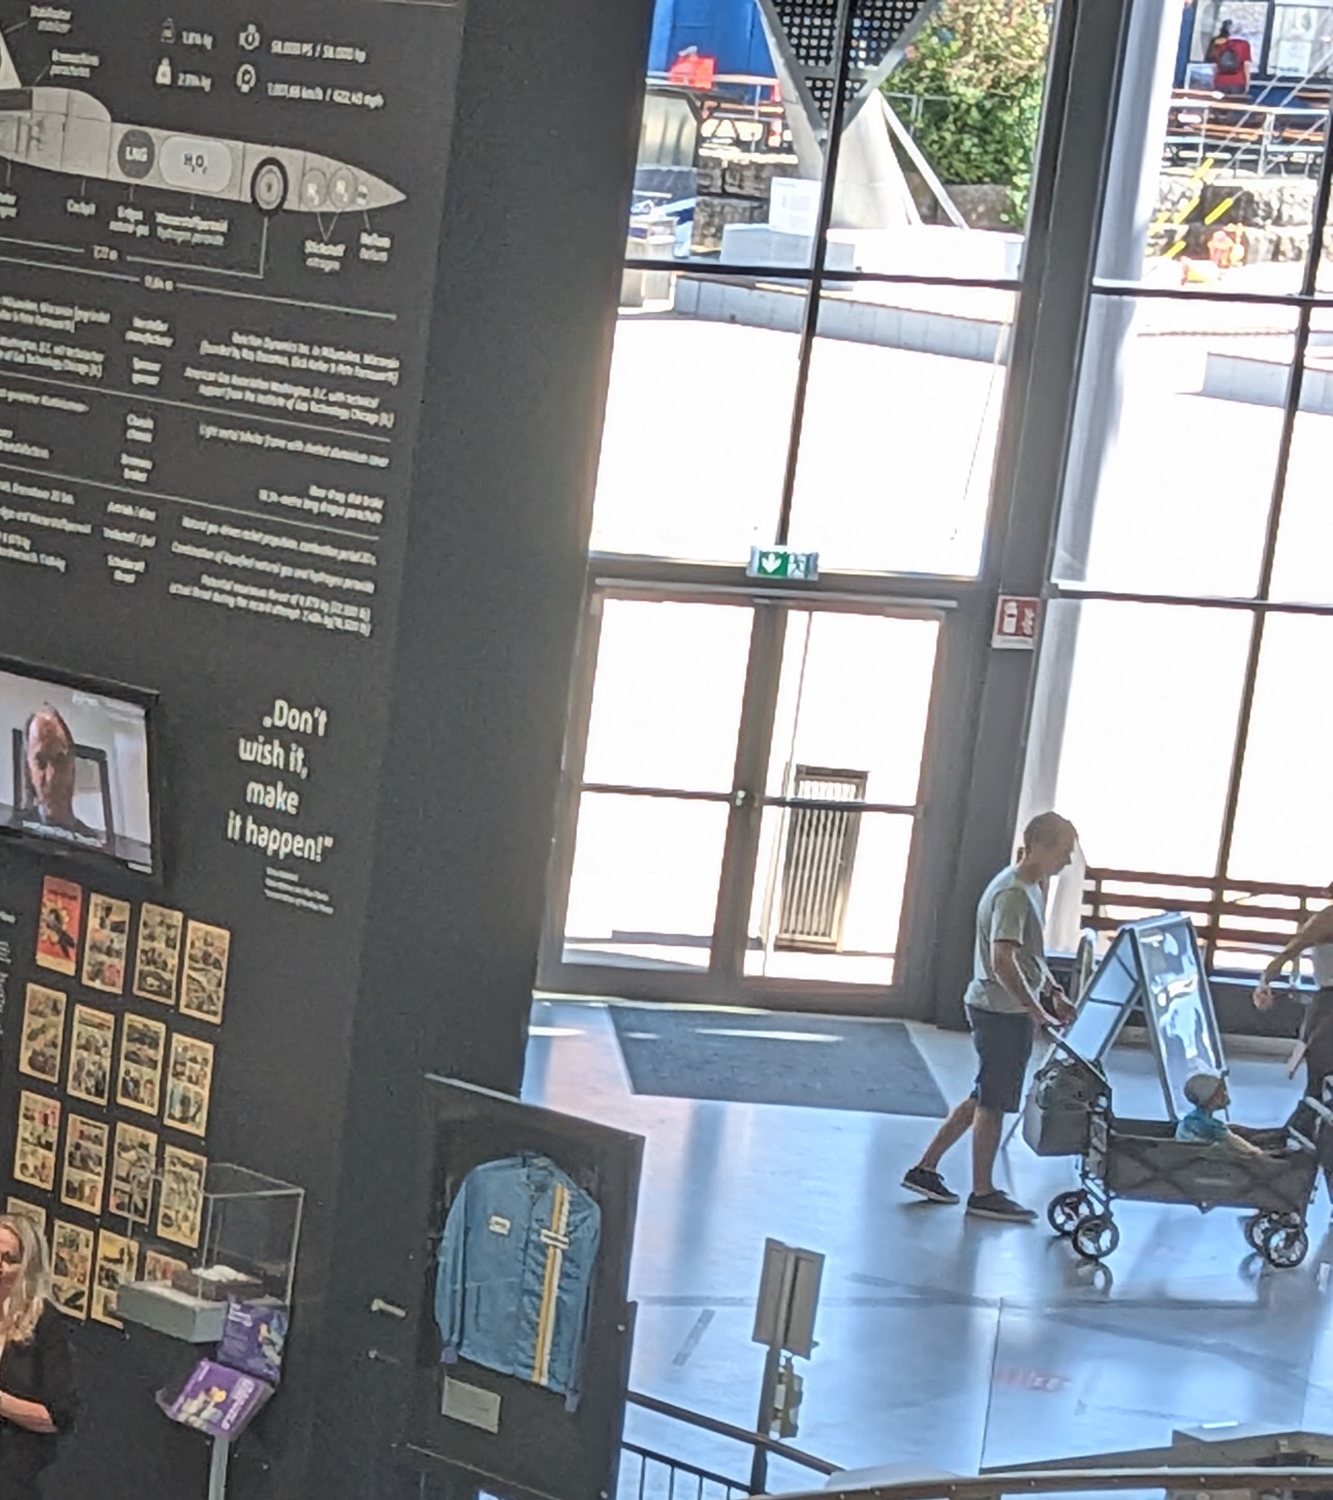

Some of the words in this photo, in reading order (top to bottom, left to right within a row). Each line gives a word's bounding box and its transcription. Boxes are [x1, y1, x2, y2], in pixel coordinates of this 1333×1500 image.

[239, 735, 284, 769] wish
[289, 743, 309, 779] it,
[247, 780, 299, 815] make
[227, 810, 242, 840] it
